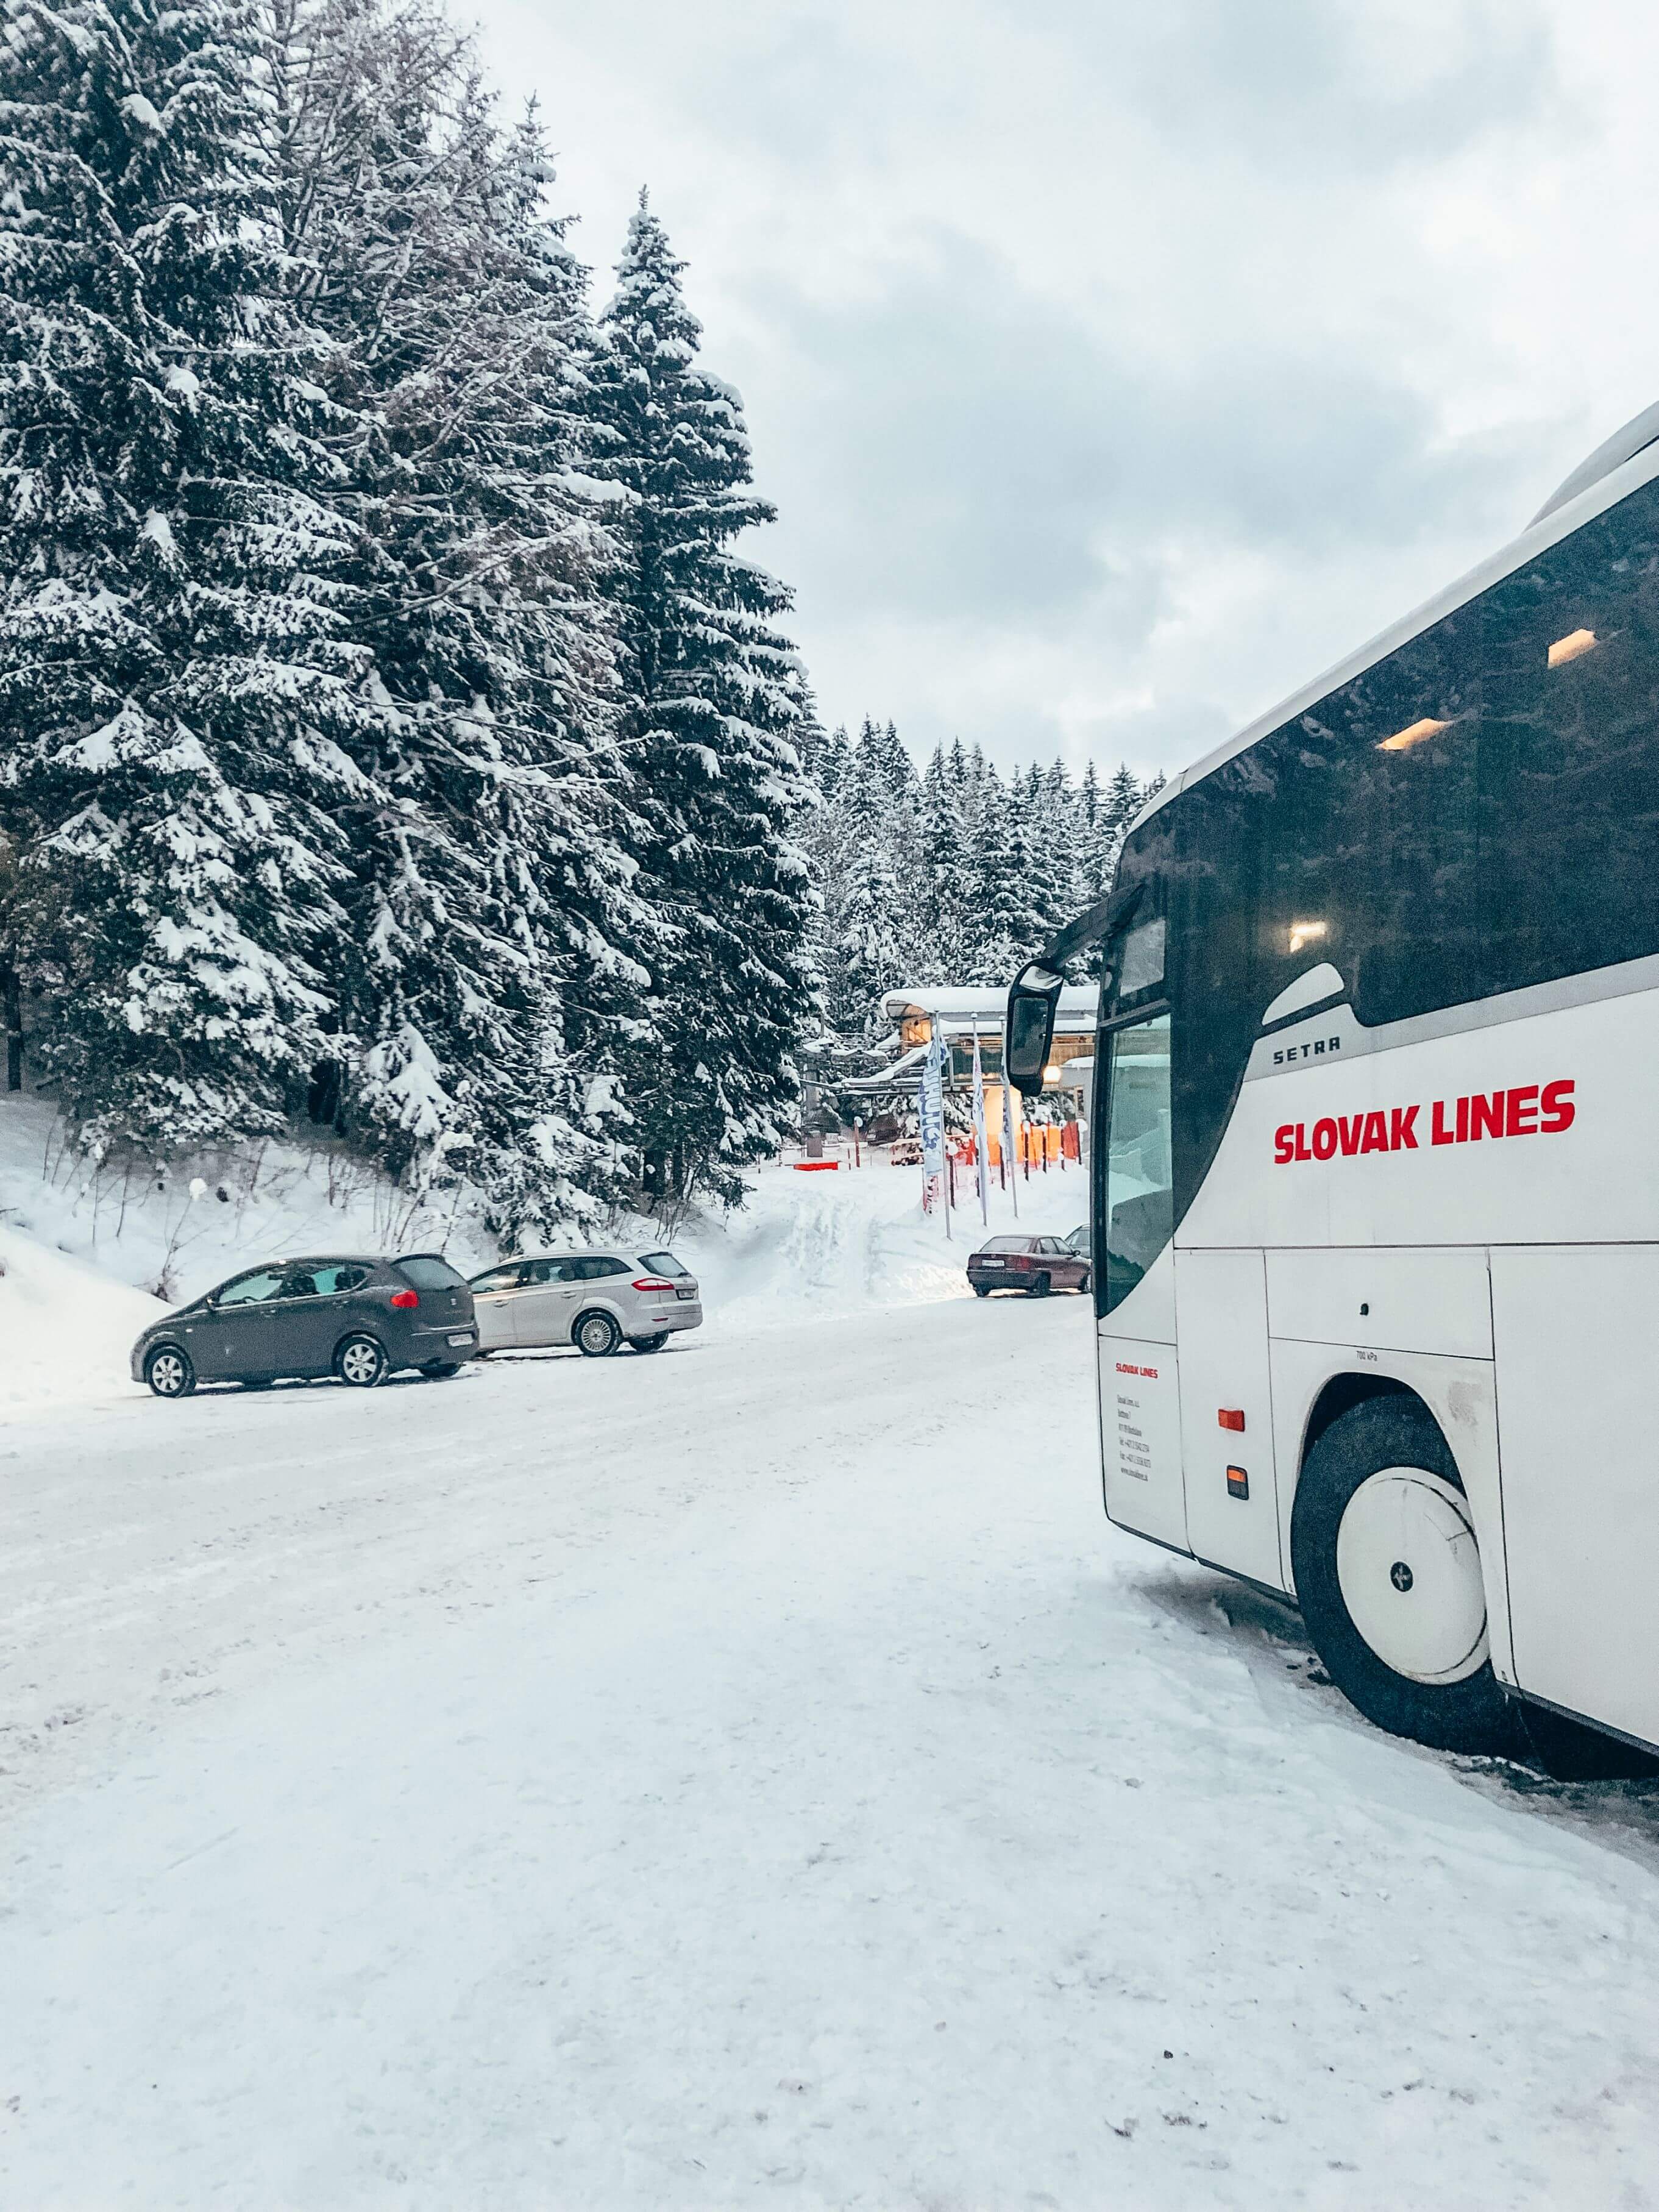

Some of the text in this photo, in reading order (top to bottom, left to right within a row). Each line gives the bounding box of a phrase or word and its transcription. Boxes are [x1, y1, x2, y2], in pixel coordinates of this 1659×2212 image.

[1273, 1036, 1340, 1064] SETRA
[1274, 1079, 1575, 1164] SLOVAK LINES
[1116, 1362, 1158, 1379] SLOVAK LINES
